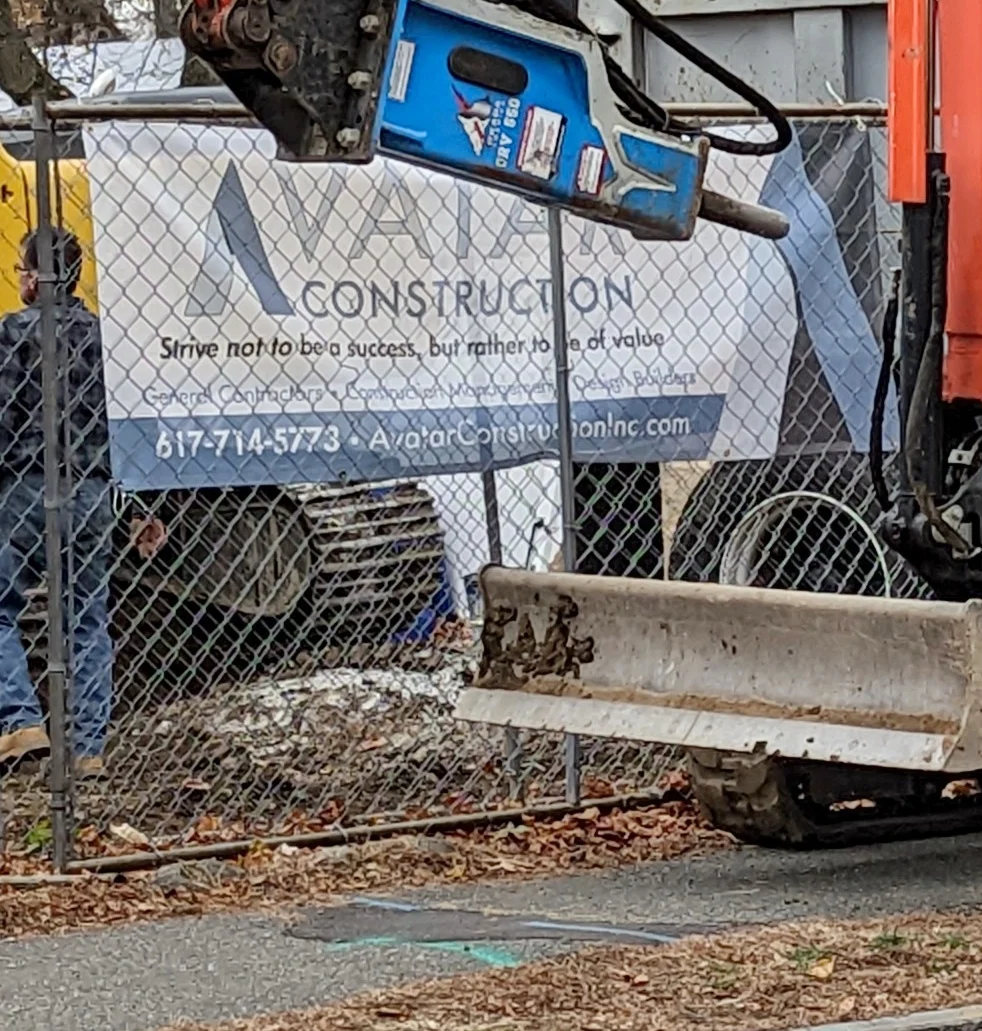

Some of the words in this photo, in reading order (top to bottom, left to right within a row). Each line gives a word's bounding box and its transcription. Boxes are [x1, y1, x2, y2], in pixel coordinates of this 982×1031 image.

[301, 274, 634, 318] CONSTRUCTON
[159, 336, 219, 360] Strive
[227, 338, 264, 357] not
[272, 336, 292, 355] to
[300, 333, 324, 355] be
[330, 343, 341, 355] a
[347, 341, 422, 360] success,
[429, 334, 459, 357] but
[467, 333, 526, 356] rather
[532, 335, 550, 353] to
[588, 329, 605, 351] of
[612, 327, 664, 348] value
[220, 385, 325, 405] Contractors
[156, 425, 341, 459] 617-714-5773
[369, 411, 690, 450] AvatarConstrucionInc.com
